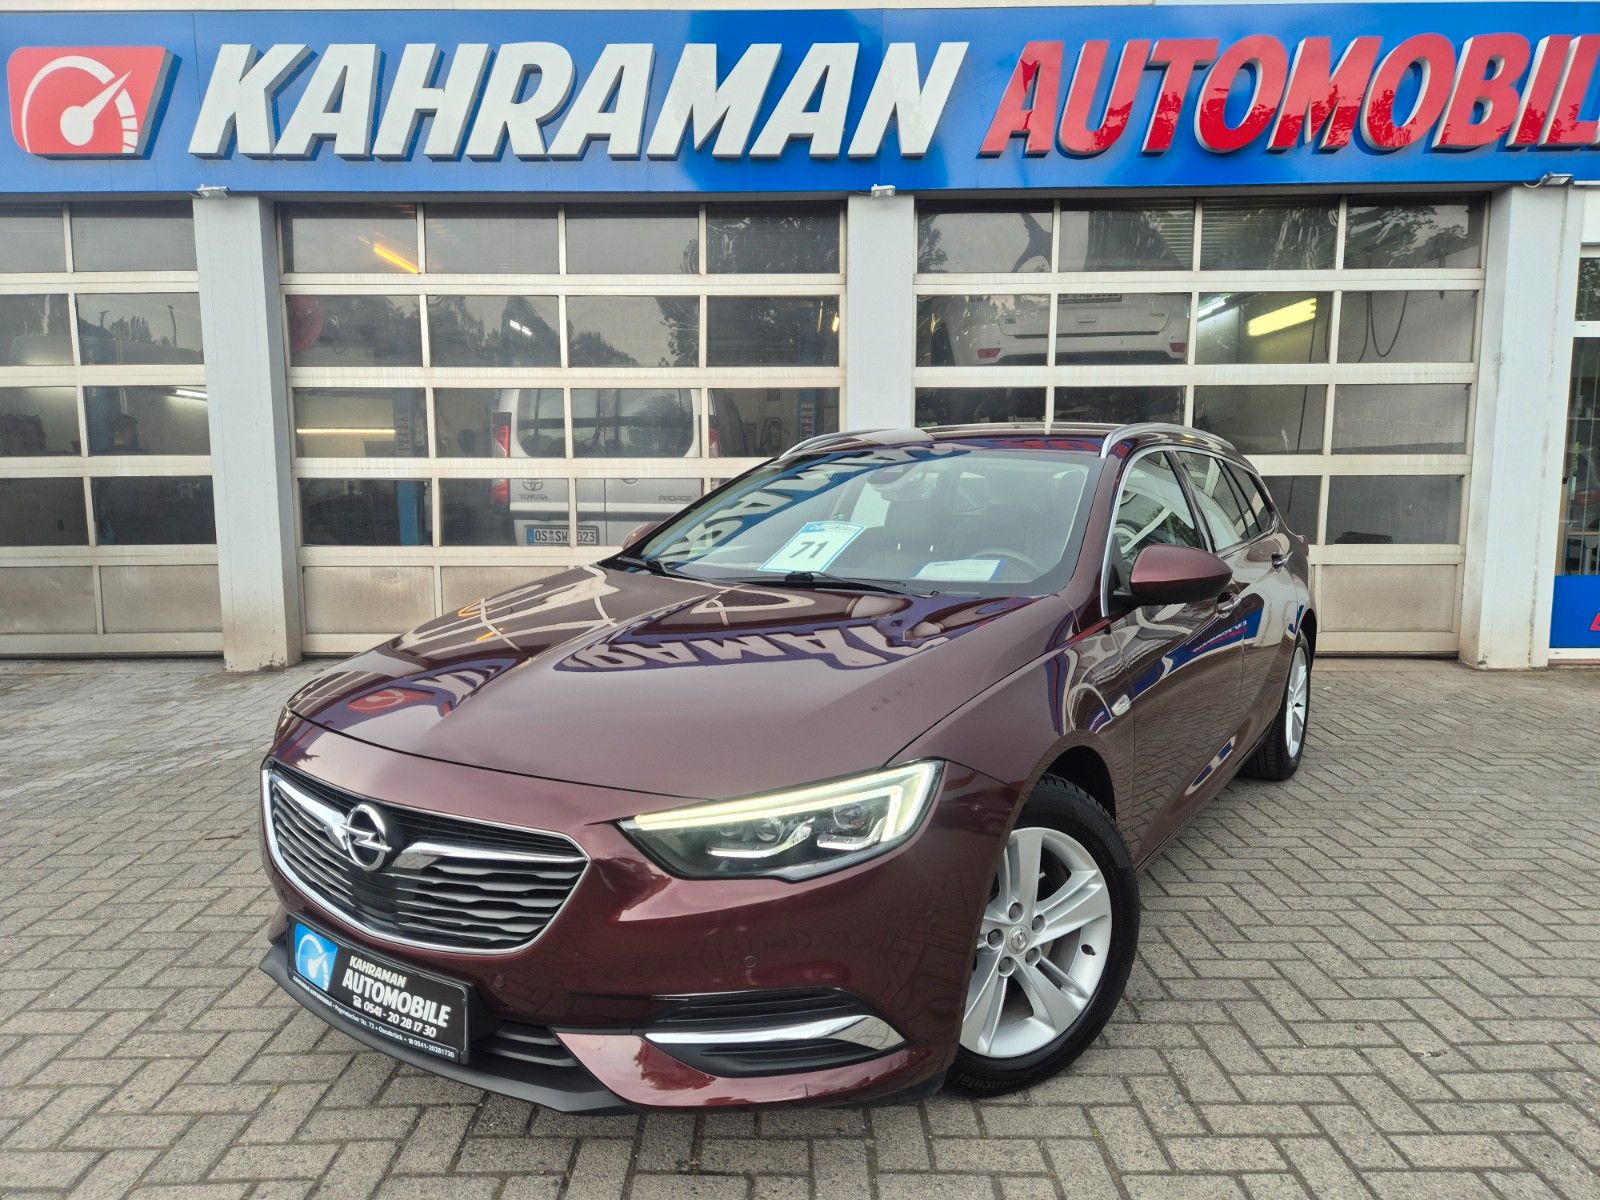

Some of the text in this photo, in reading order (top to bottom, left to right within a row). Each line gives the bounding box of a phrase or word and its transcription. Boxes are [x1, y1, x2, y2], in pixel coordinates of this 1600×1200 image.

[189, 32, 1600, 159] KAHRAMAN AUTOMOBIL
[535, 529, 548, 542] OS
[790, 541, 829, 559] 71
[349, 955, 407, 988] KAHRAMAN
[342, 968, 451, 1028] AUTOMOBILE
[387, 1013, 400, 1027] 20
[400, 1018, 413, 1032] 28
[422, 1025, 437, 1038] 30
